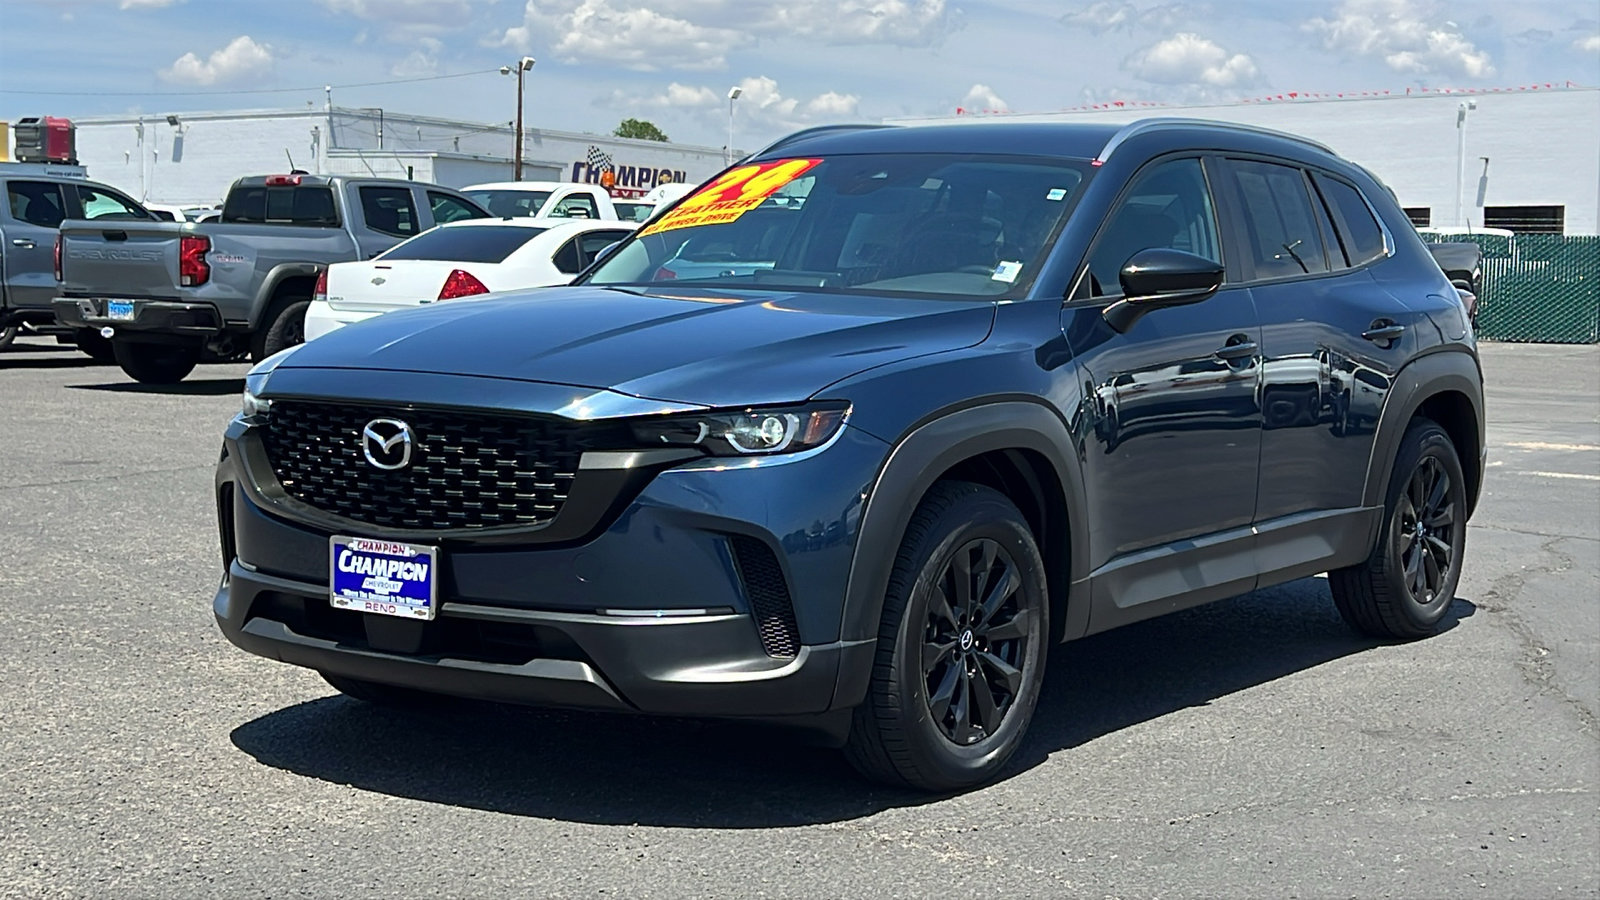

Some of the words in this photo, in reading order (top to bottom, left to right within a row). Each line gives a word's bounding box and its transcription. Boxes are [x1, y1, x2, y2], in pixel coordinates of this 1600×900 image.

[701, 211, 740, 223] DRIVE
[69, 248, 163, 262] CHEVROLET
[357, 540, 406, 555] CHAMPION
[338, 549, 428, 582] CHAMPION
[365, 580, 399, 590] CHEVROLET
[365, 602, 397, 614] RENO
